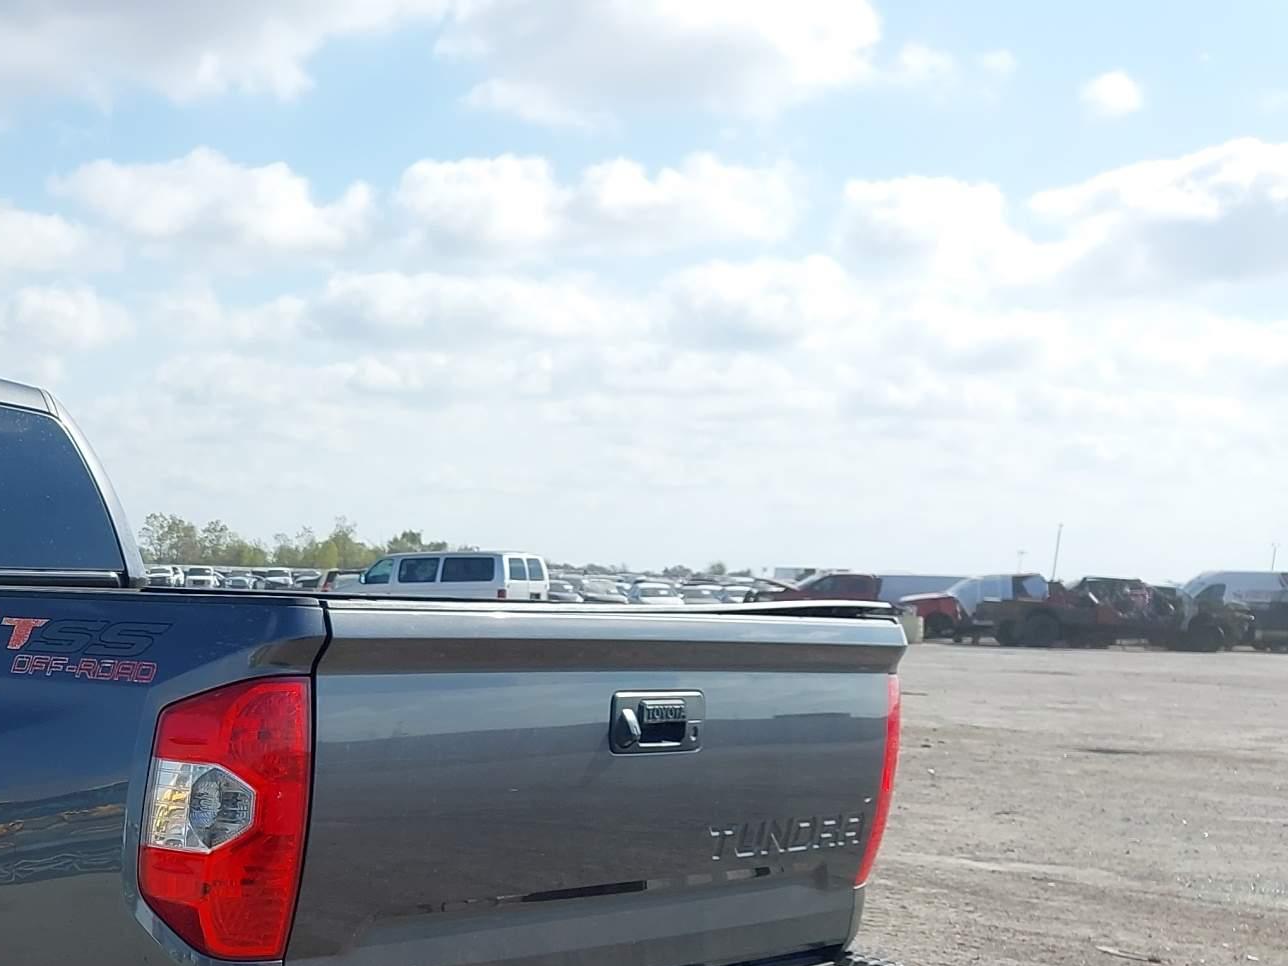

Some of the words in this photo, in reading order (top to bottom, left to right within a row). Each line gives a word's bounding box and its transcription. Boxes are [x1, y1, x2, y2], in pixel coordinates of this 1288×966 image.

[0, 616, 173, 658] TSS
[10, 654, 159, 684] OFF-ROAD
[708, 812, 865, 861] TUNDRA
